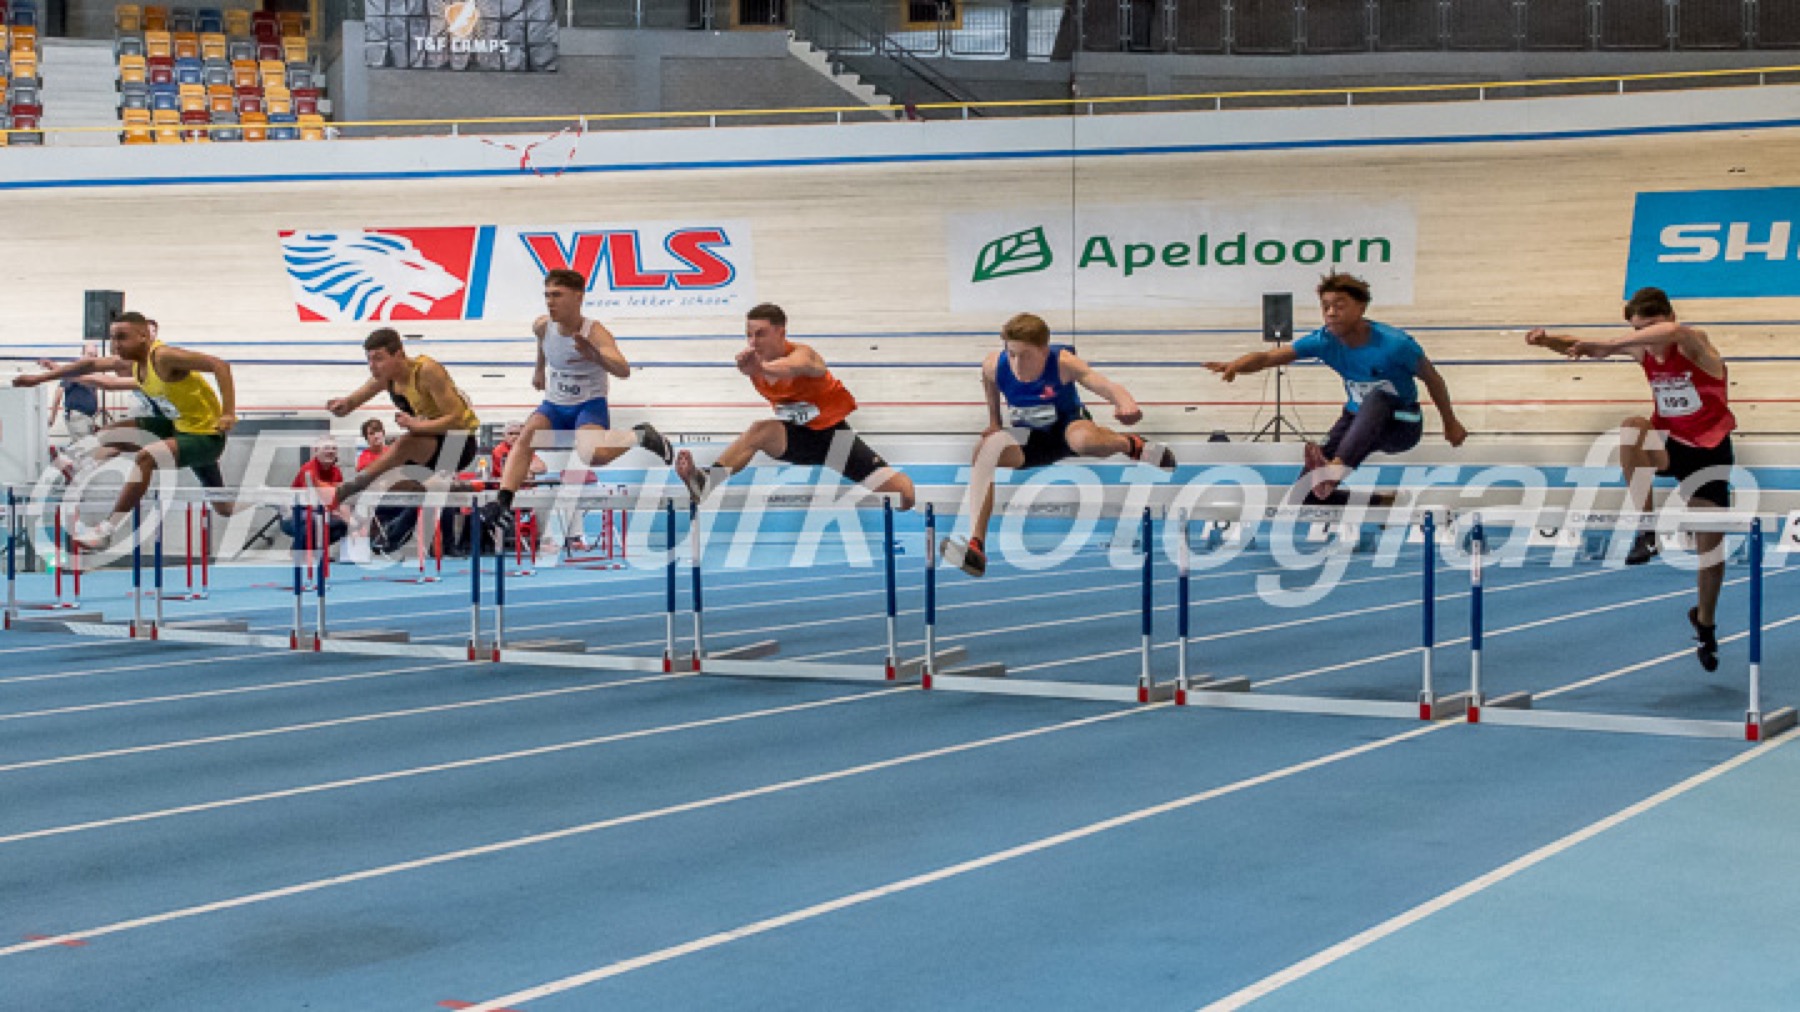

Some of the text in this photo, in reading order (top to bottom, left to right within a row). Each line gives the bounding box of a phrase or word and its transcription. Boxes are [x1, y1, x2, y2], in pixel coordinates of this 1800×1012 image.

[415, 36, 509, 53] T&F CAMPS
[518, 227, 736, 292] VLS
[1078, 232, 1391, 277] Apeldoorn
[1657, 221, 1800, 263] SH
